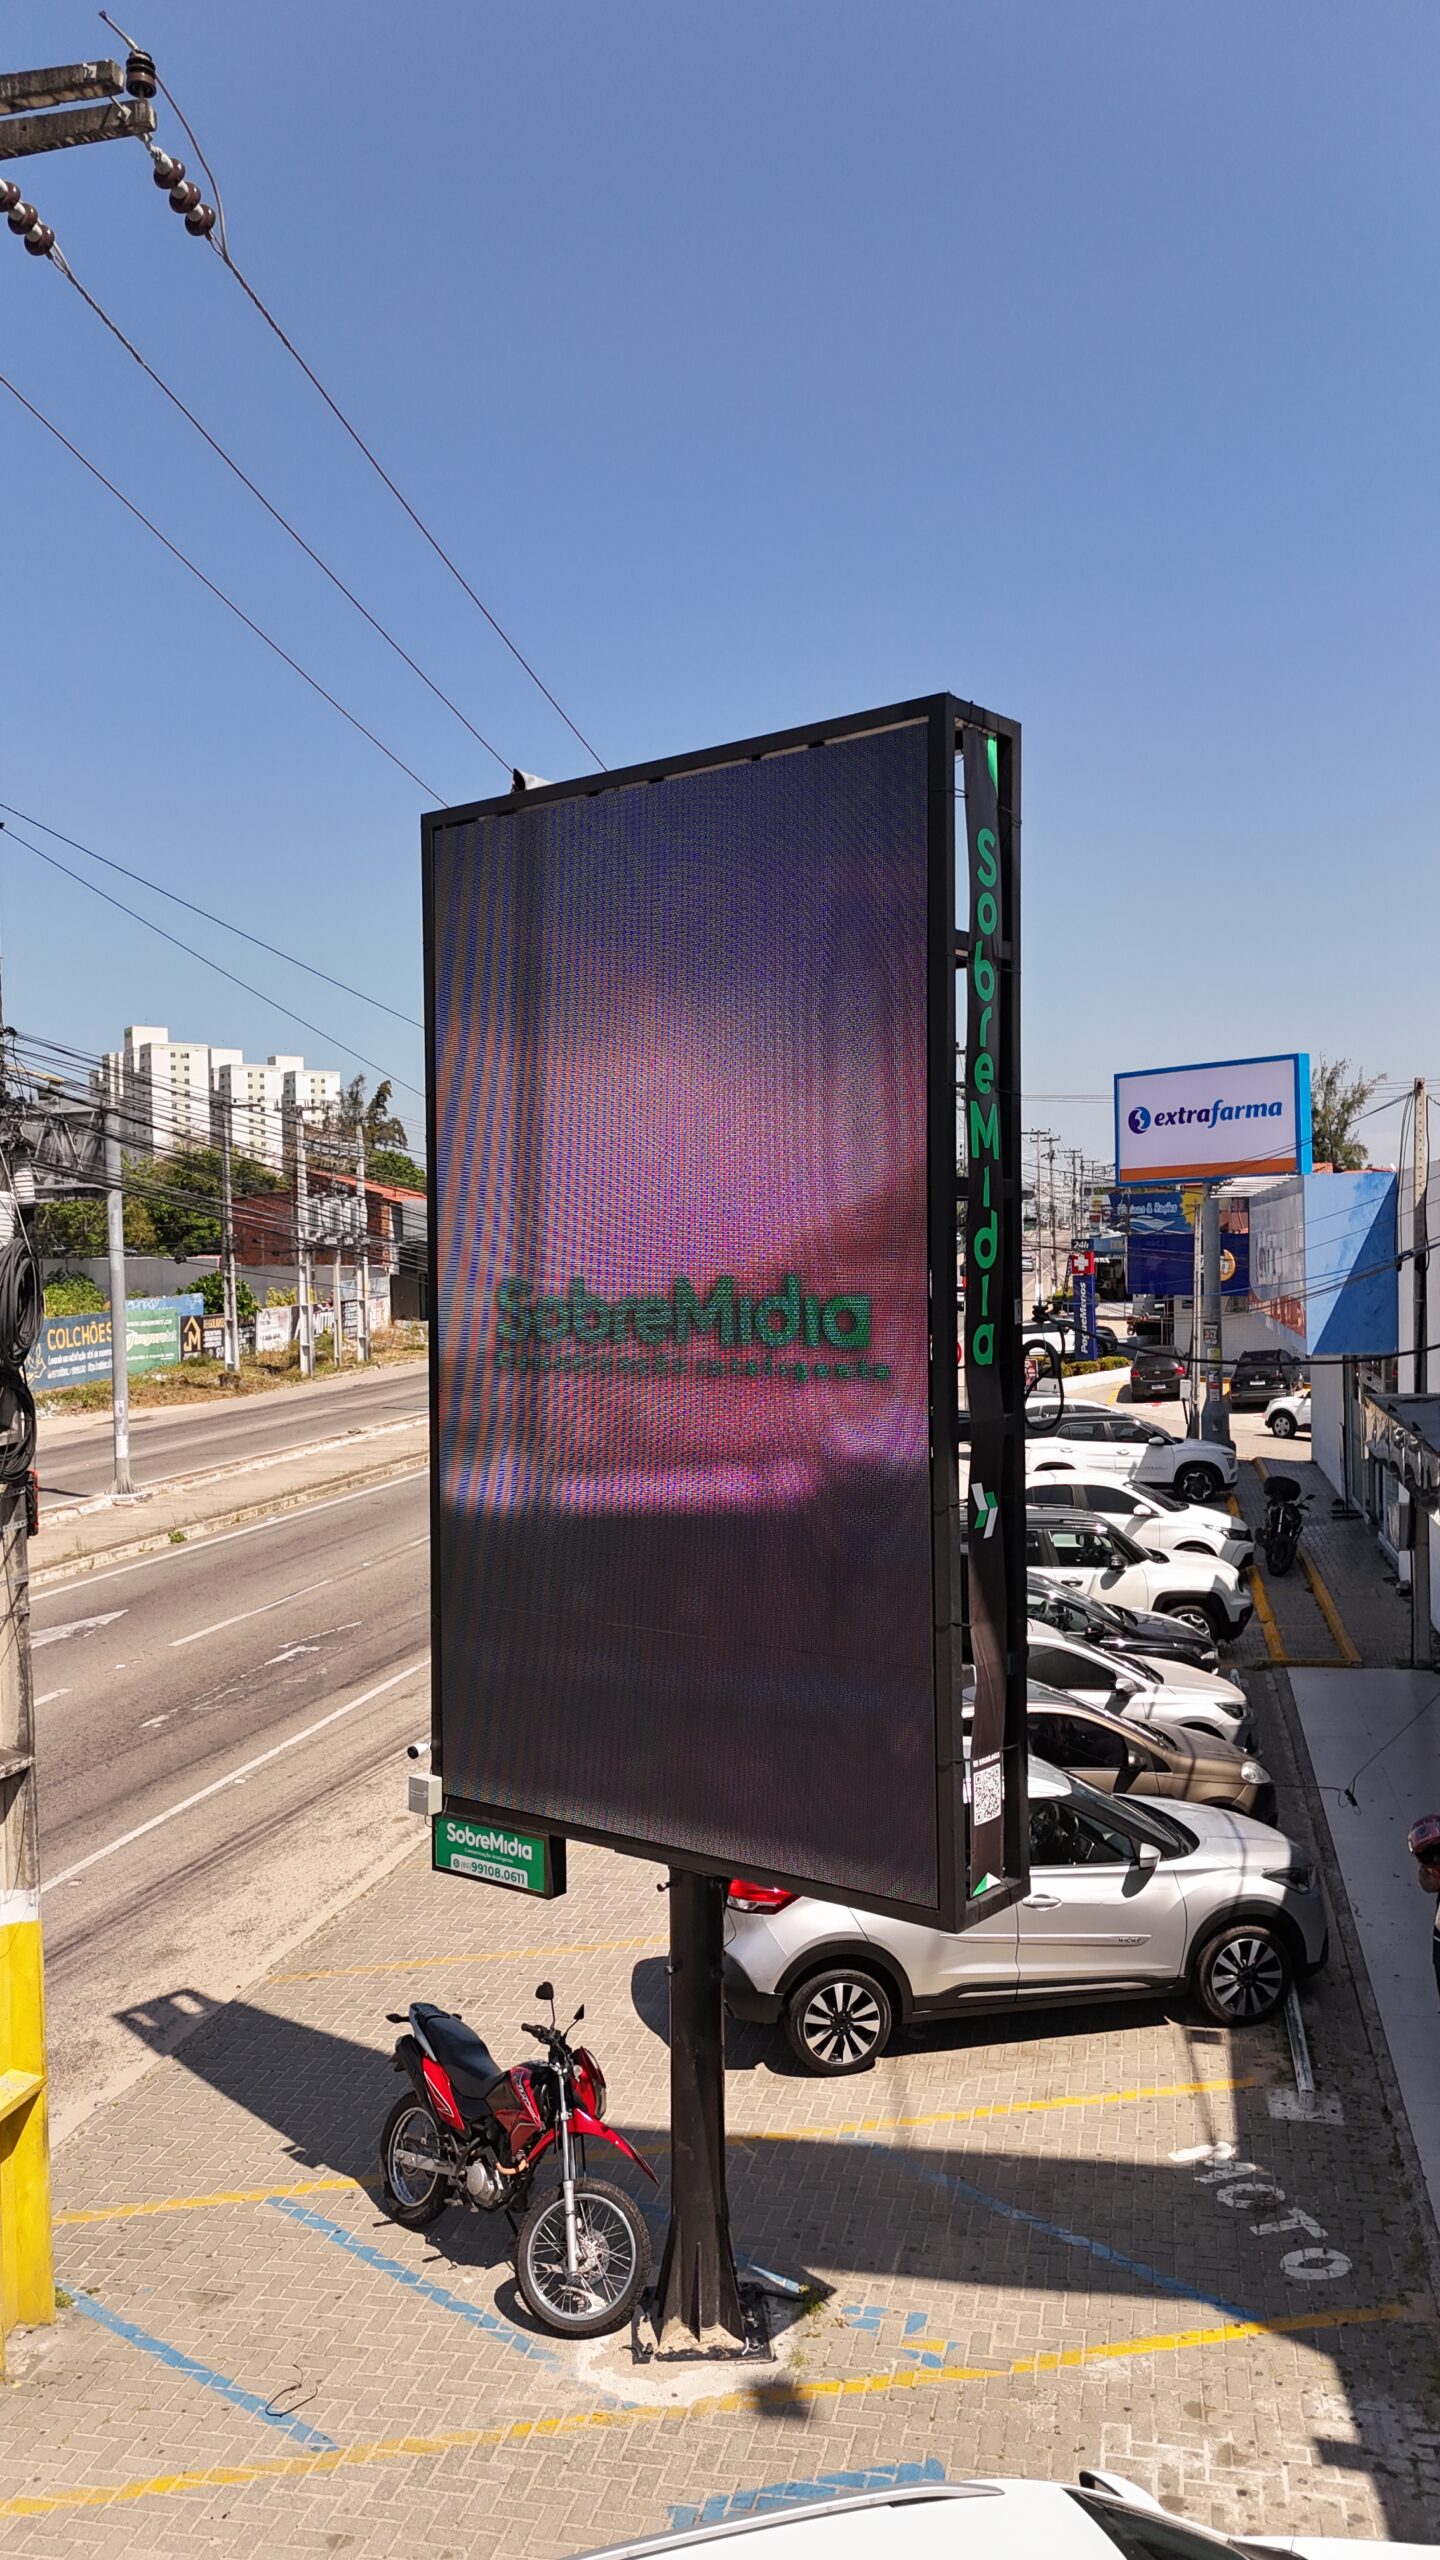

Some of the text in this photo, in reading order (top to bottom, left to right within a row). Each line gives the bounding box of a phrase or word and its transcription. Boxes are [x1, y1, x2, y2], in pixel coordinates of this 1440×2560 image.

[1154, 1099, 1283, 1129] extrafarma
[1073, 1241, 1089, 1249] 24h
[497, 1272, 872, 1349] SobreMidia
[46, 1321, 112, 1351] COLCHÕES
[446, 1822, 533, 1860] SobreMidia
